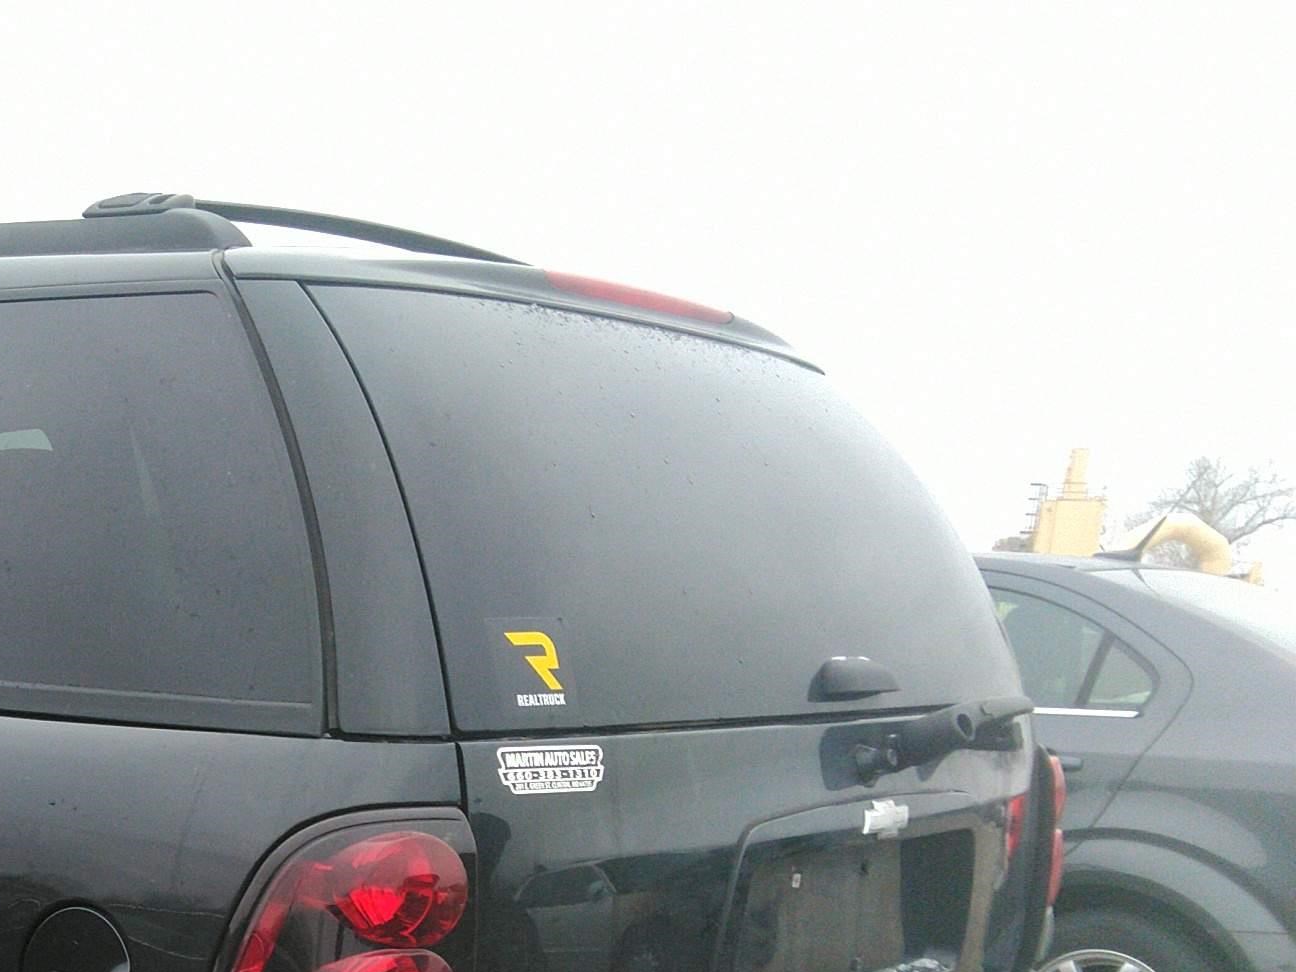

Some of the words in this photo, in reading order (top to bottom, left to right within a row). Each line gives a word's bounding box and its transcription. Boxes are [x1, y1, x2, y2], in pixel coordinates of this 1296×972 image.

[516, 693, 567, 707] REALTRUCK
[505, 752, 544, 768] MARTIN
[545, 751, 570, 767] AUTO
[570, 750, 596, 766] SALES
